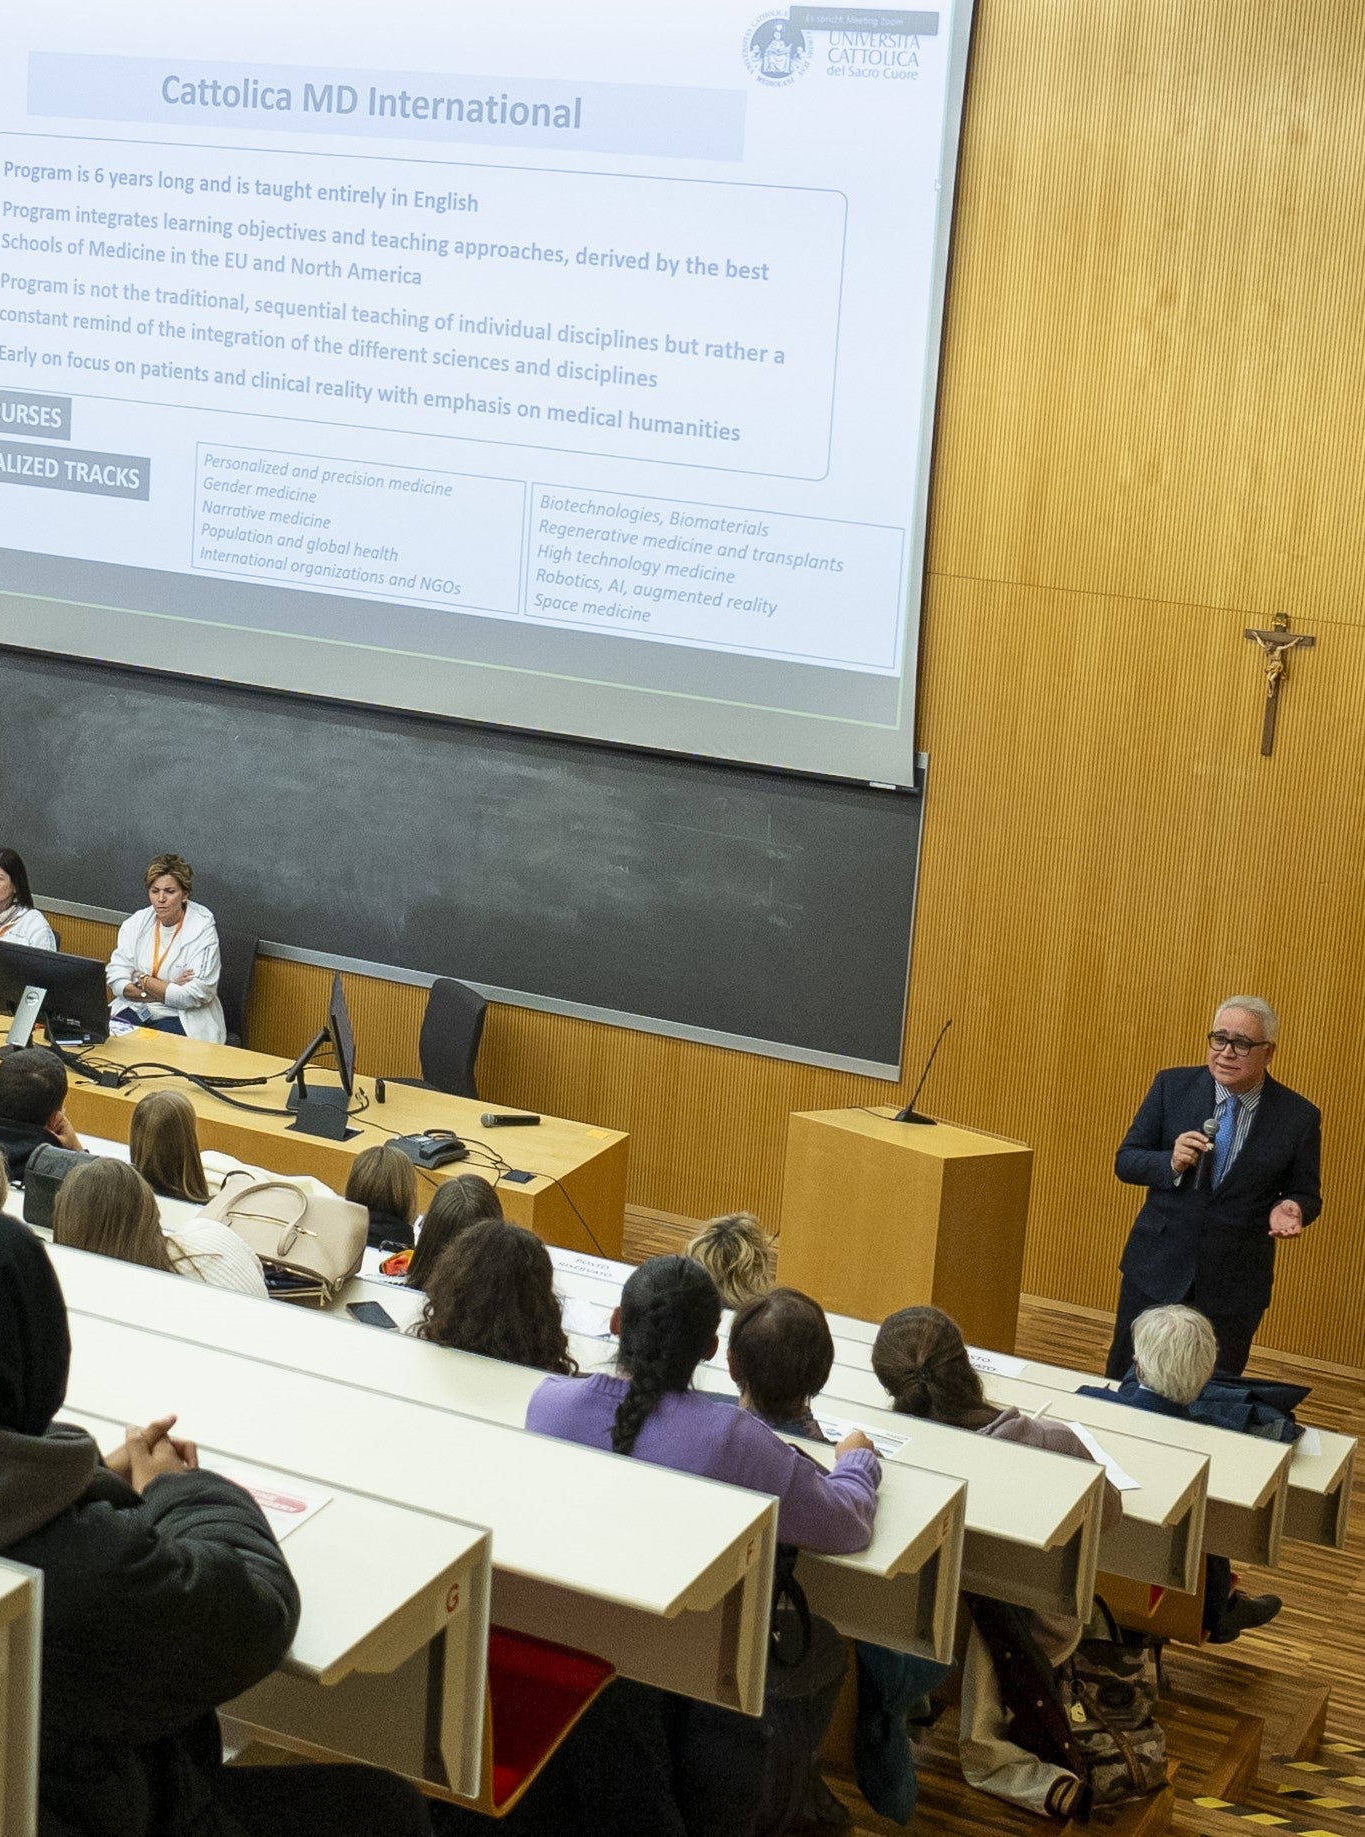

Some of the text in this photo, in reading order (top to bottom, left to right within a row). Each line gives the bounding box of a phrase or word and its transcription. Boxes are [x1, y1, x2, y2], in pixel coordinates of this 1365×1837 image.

[826, 65, 919, 80] del Sacro Cuore
[827, 47, 920, 68] CATTOLICA
[162, 74, 581, 128] Cattolica MD International
[4, 161, 478, 214] Program is 6 years long and is taught entirely in English
[2, 232, 421, 285] Schools of Medicine in the EU and North America
[3, 200, 769, 281] Program integrates learning objectives and teaching approaches, derived by the best
[1, 272, 785, 364] Program is not the traditional, sequential teaching of individual disciplines but rather a
[0, 309, 657, 388] constant remind of the integration of the different sciences and disciplines
[42, 352, 61, 367] on
[67, 350, 109, 372] focus
[115, 360, 135, 375] on
[141, 361, 209, 382] patients
[214, 368, 245, 386] and
[252, 370, 310, 393] clinical
[316, 379, 373, 404] reality
[378, 384, 417, 405] with
[424, 393, 511, 416] emphasis
[517, 403, 540, 419] on
[547, 405, 622, 429] medical
[629, 410, 740, 442] humanities
[64, 460, 139, 489] TRACKS
[203, 476, 317, 504] Gender medicine
[204, 452, 452, 497] Personalized and precision medicine
[202, 499, 331, 530] Narrative medicine
[540, 494, 769, 537] Biotechnologies, Biomaterials
[201, 522, 398, 562] Population and global health
[539, 519, 844, 573] Regenerative medicine and transplants
[200, 546, 461, 595] International organizations and NGOs
[537, 544, 735, 584] High technology medicine
[534, 592, 651, 623] Space medicine
[536, 568, 777, 618] Robotics, AI, augmented reality
[558, 1261, 613, 1277] RISERVATO
[576, 1258, 610, 1270] POSTO
[942, 1514, 950, 1537] E
[745, 1538, 755, 1567] F
[446, 1582, 459, 1613] G
